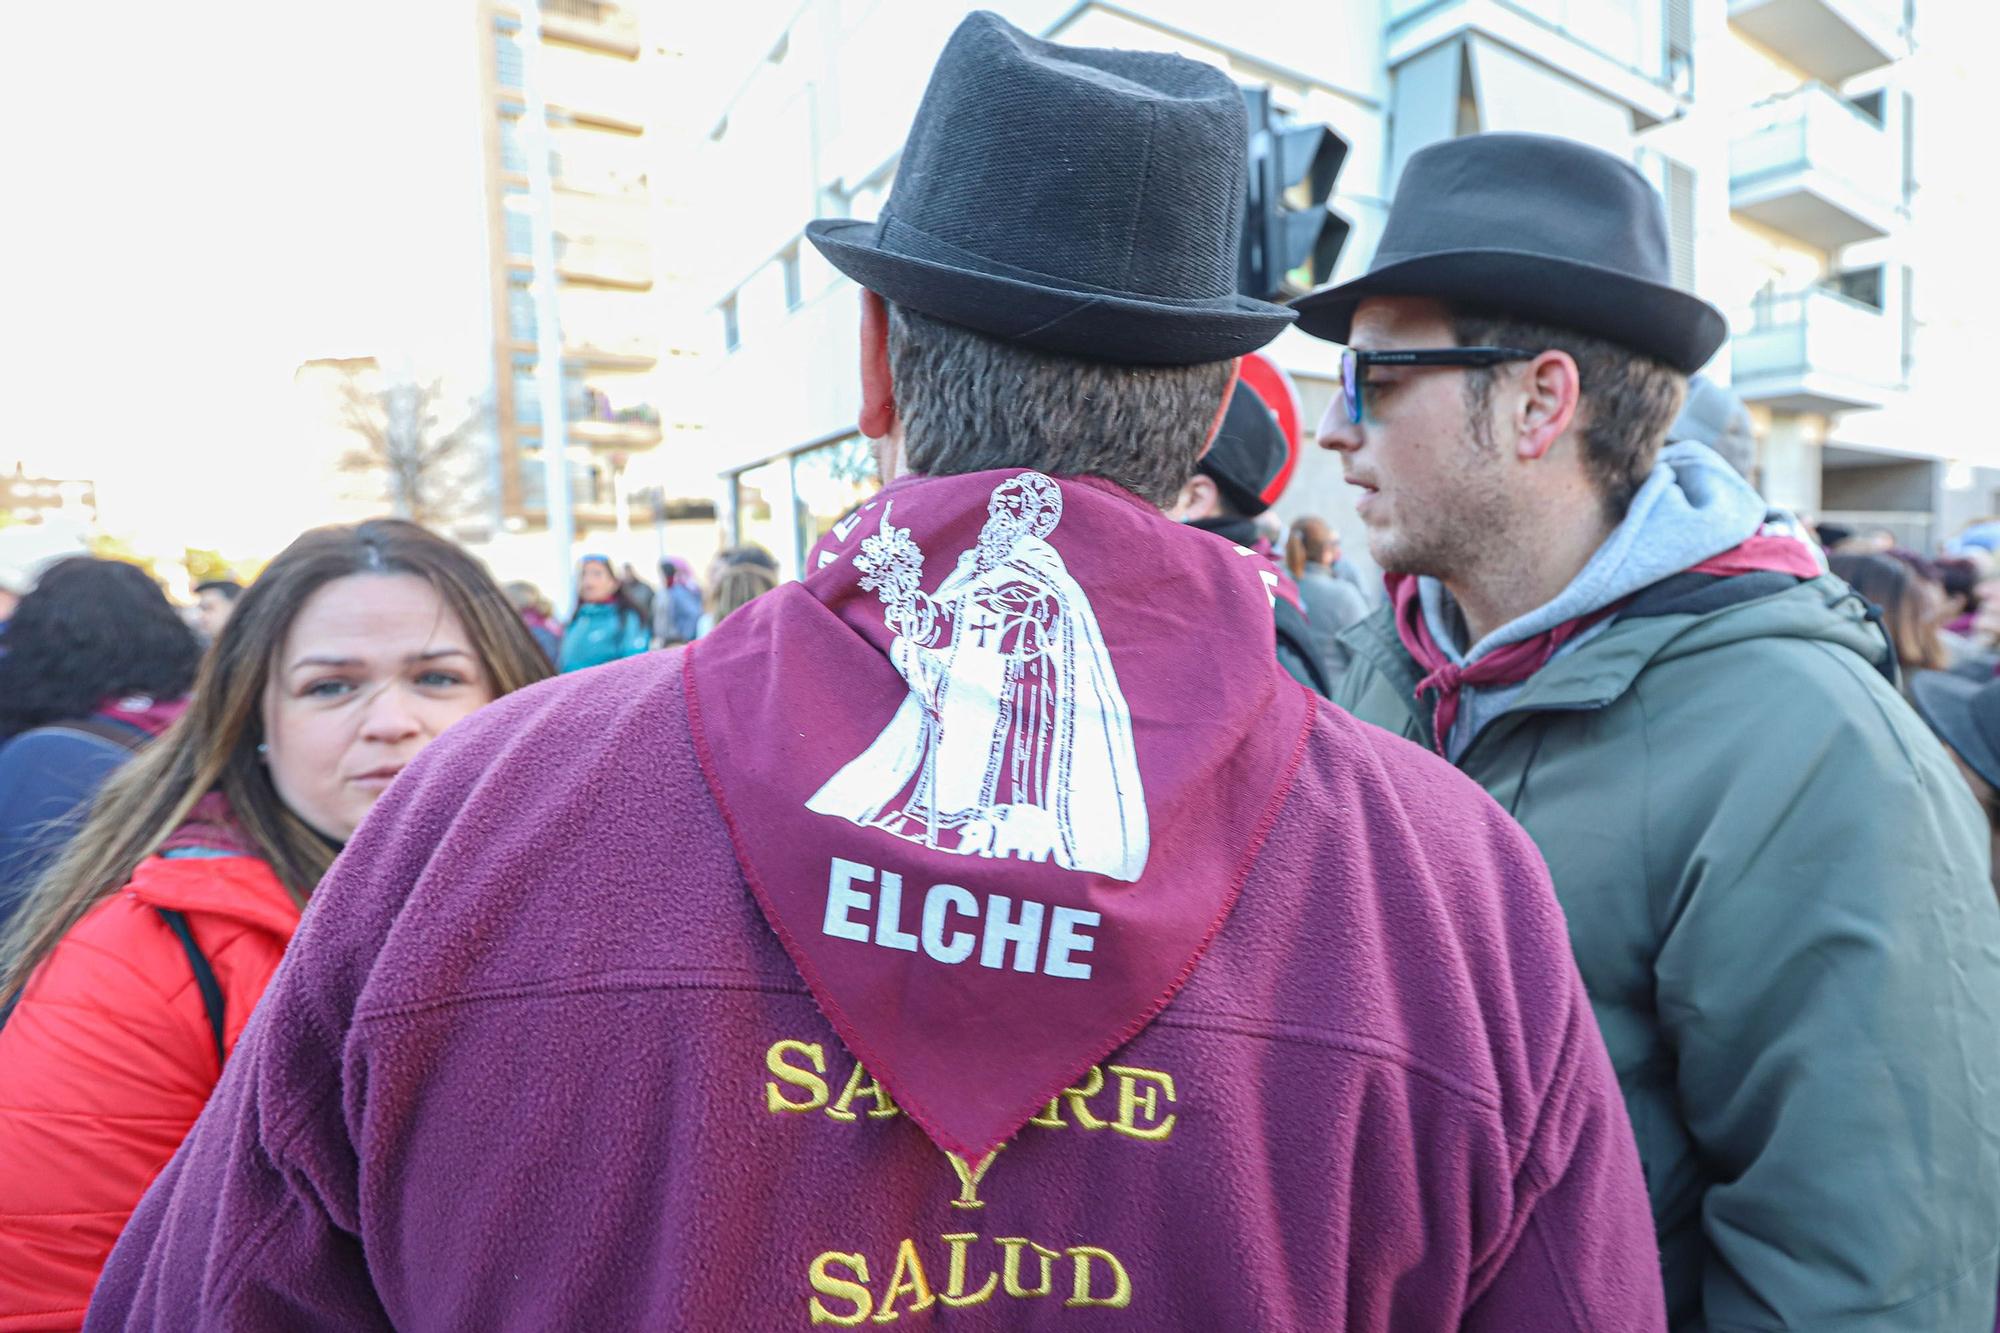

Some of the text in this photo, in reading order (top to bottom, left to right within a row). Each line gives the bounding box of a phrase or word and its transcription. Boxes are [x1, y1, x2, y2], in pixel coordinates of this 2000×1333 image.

[822, 857, 1101, 980] ELCHE
[765, 1039, 1177, 1141] SARE
[945, 1143, 1007, 1208] Y
[808, 1232, 1132, 1326] SALUD
